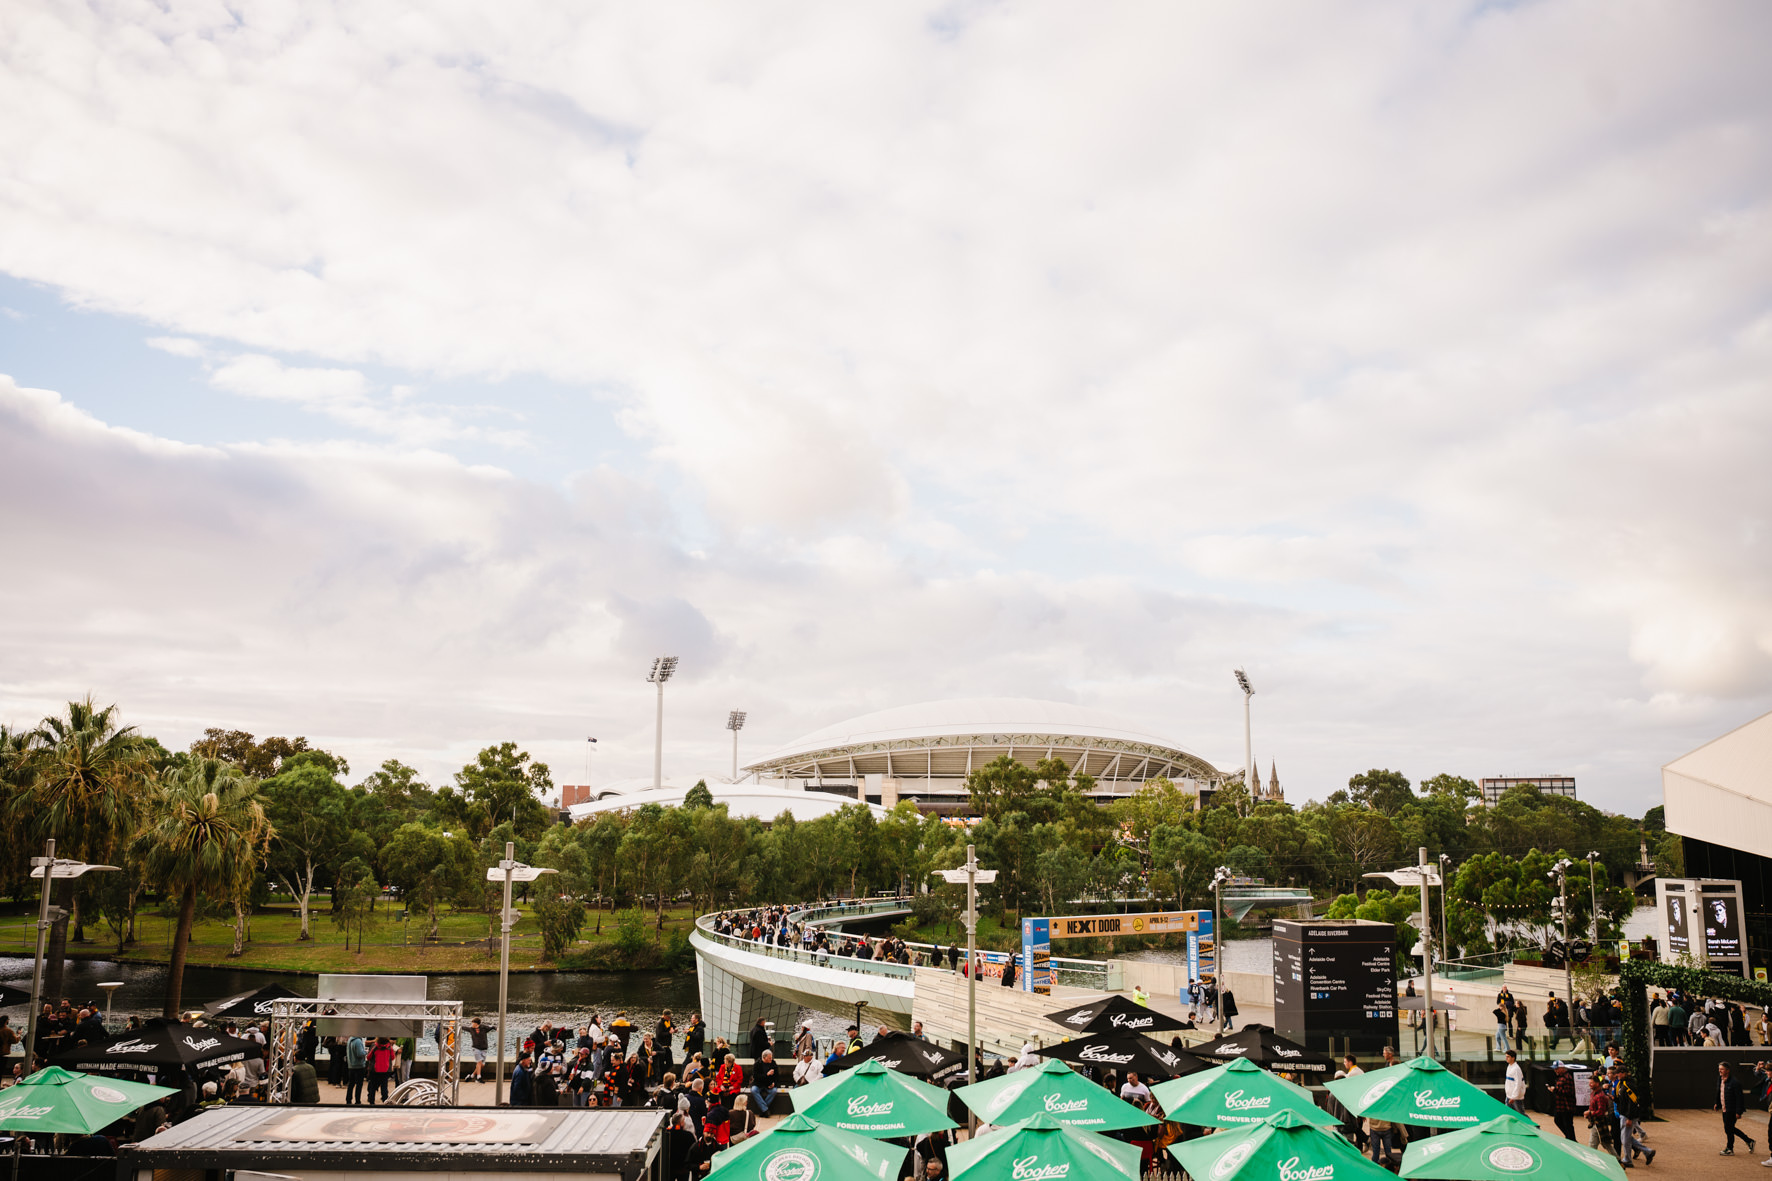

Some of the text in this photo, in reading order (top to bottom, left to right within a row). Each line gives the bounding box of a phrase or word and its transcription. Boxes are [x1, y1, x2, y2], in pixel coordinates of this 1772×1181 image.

[1067, 920, 1096, 934] NEXT
[1098, 919, 1121, 932] DOOR
[183, 1036, 221, 1052] Coopers
[1079, 1044, 1135, 1064] Coopers
[847, 1095, 894, 1118] Coopers
[1044, 1093, 1088, 1114] Coopers
[1225, 1090, 1271, 1110] Coopers
[1414, 1090, 1461, 1109] Coopers
[837, 1122, 870, 1130] FOREVER
[1012, 1155, 1070, 1181] Coopers
[1277, 1156, 1334, 1181] Coopers
